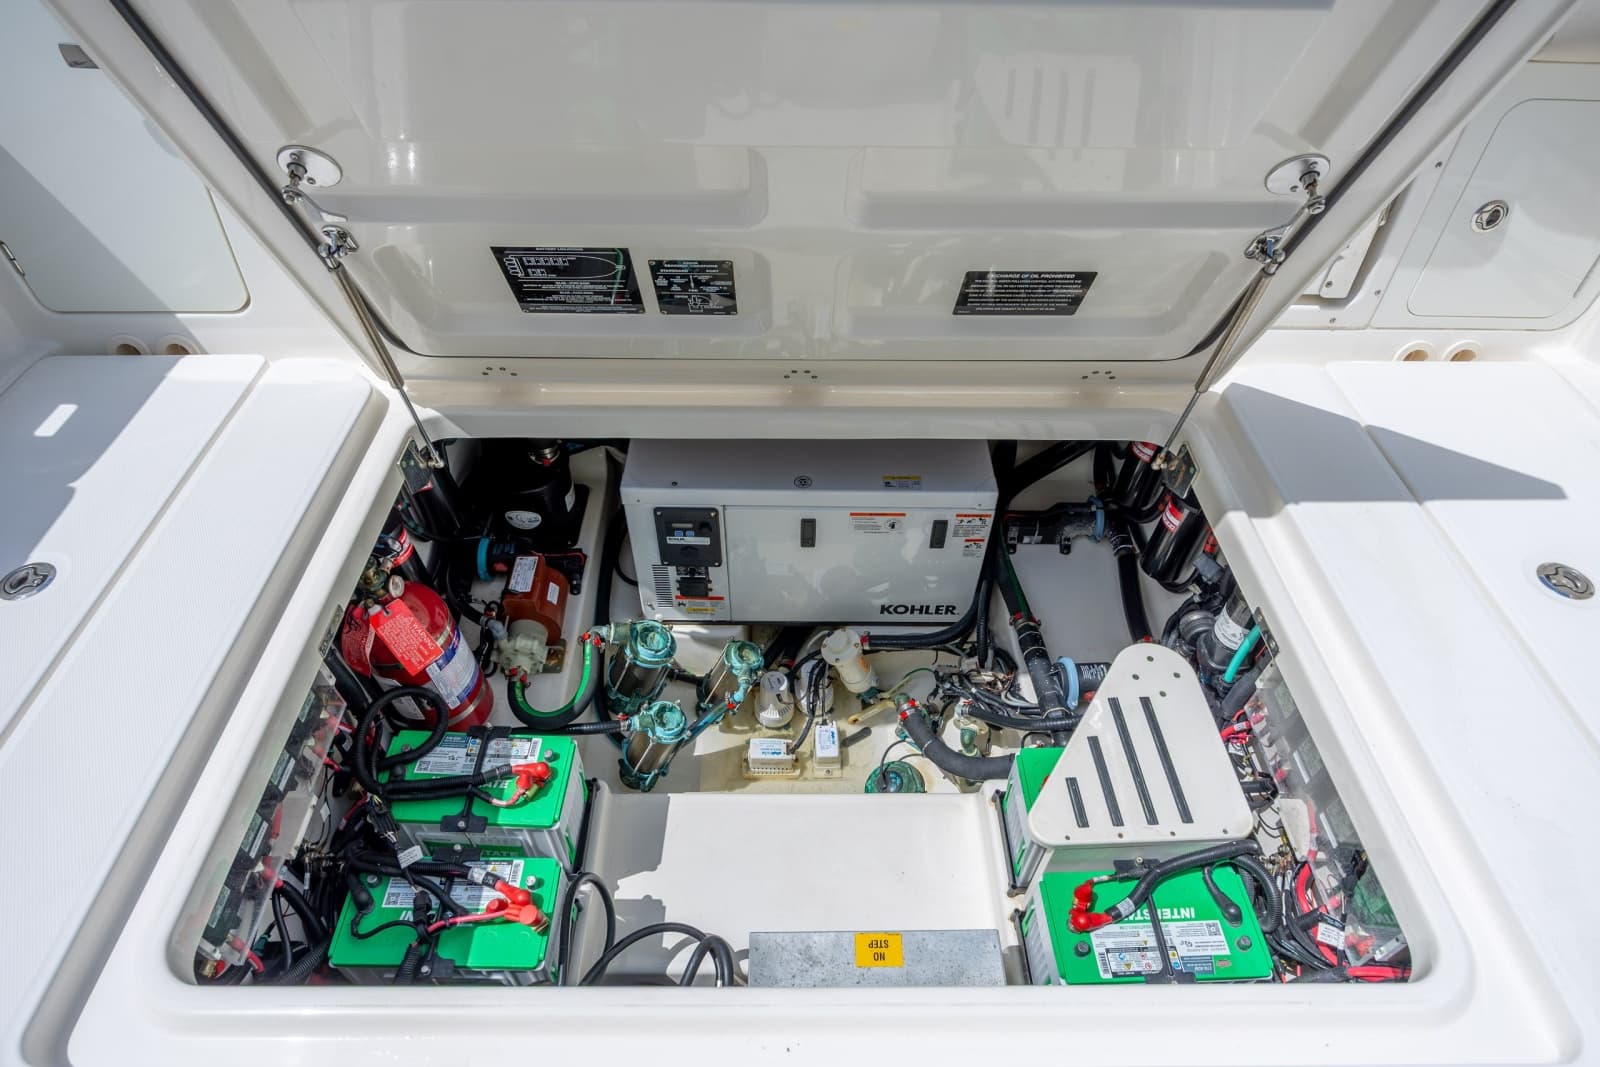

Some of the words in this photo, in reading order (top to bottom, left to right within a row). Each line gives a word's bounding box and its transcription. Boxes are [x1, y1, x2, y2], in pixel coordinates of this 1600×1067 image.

[1124, 907, 1196, 920] INTESTA
[868, 939, 889, 949] STEP
[873, 951, 886, 962] NO
